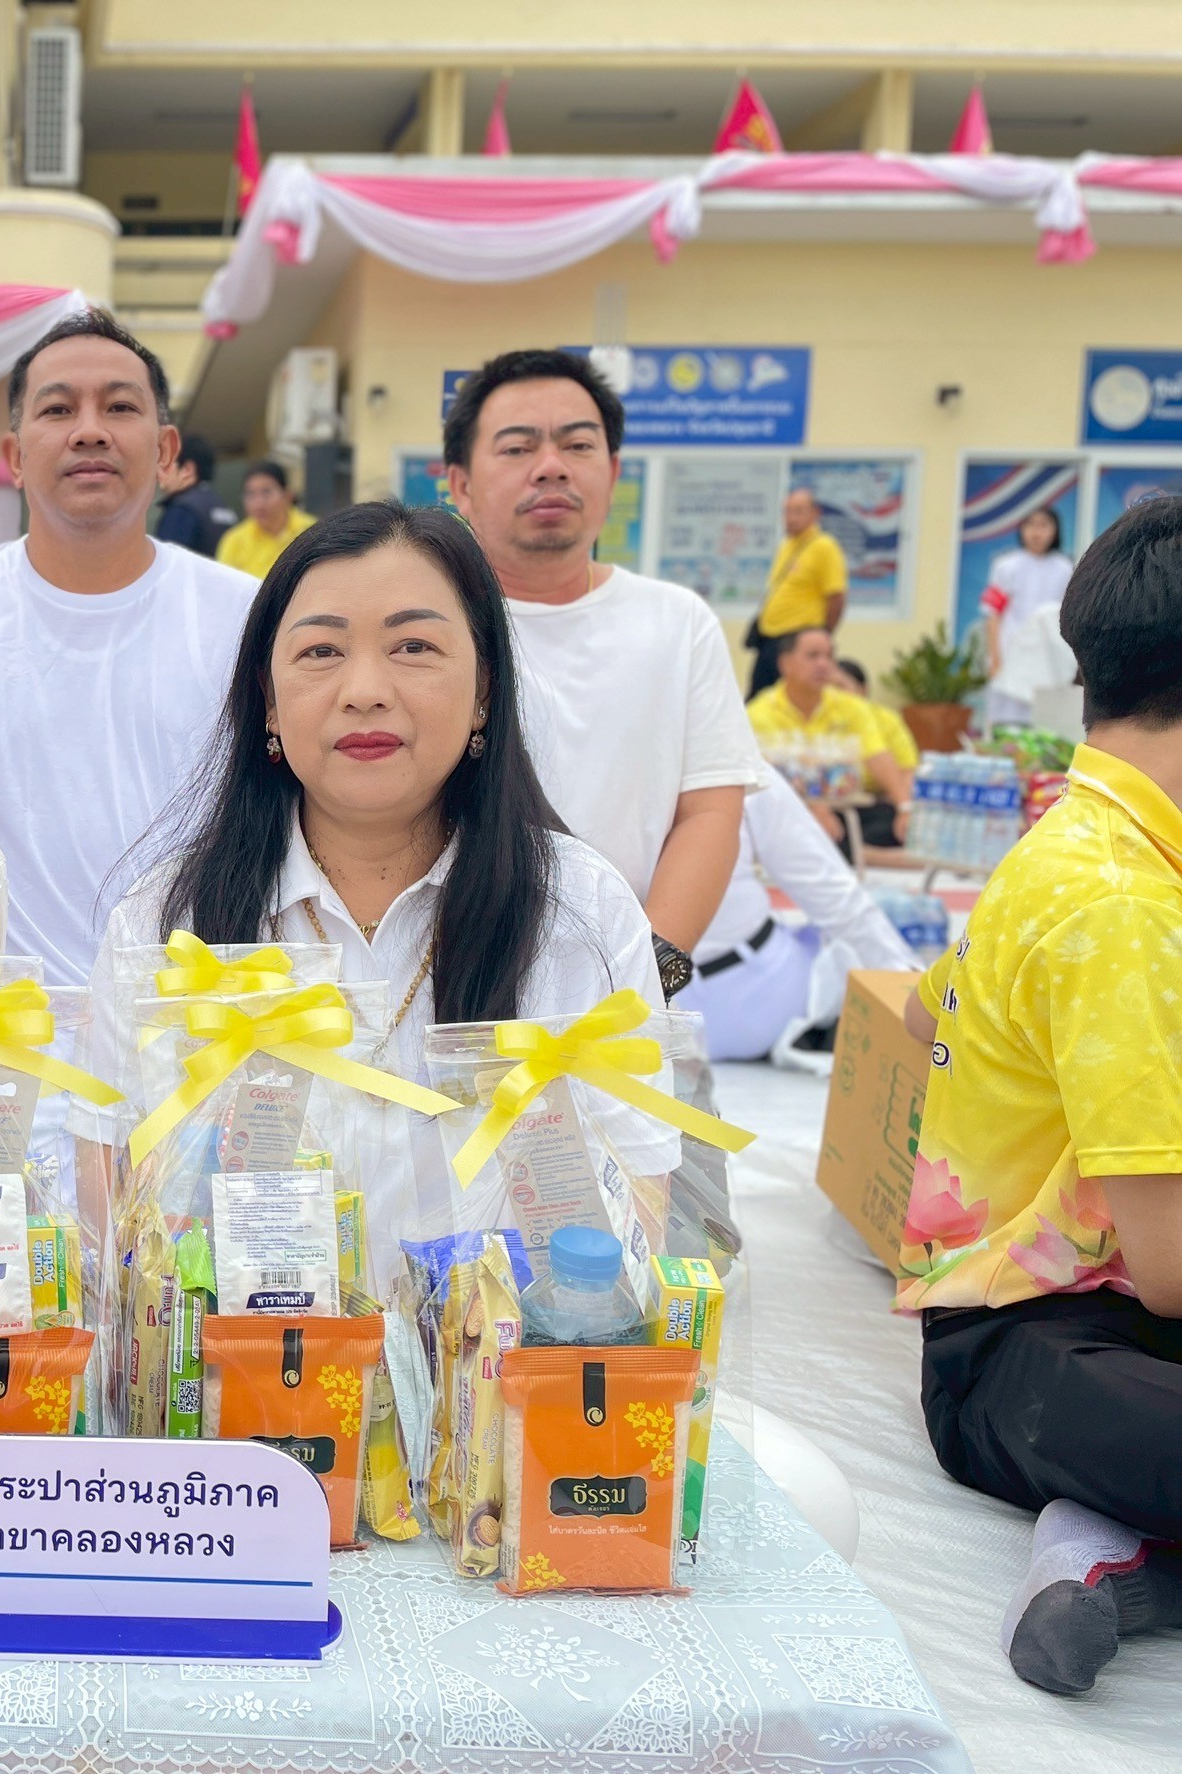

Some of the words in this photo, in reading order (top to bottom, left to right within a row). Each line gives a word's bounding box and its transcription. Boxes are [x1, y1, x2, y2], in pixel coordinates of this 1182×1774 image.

[249, 1088, 299, 1102] Colgate
[511, 1112, 564, 1131] olgate
[57, 1238, 65, 1260] Clean
[32, 1240, 44, 1286] Double
[42, 1239, 55, 1283] Action
[256, 1292, 306, 1306] พาราเทมป์
[696, 1299, 707, 1321] Clean
[664, 1297, 681, 1342] Double
[677, 1298, 694, 1342] Action
[692, 1327, 703, 1349] Fresh
[487, 1413, 500, 1465] CHOCOLATE
[572, 1482, 625, 1504] ธรรม
